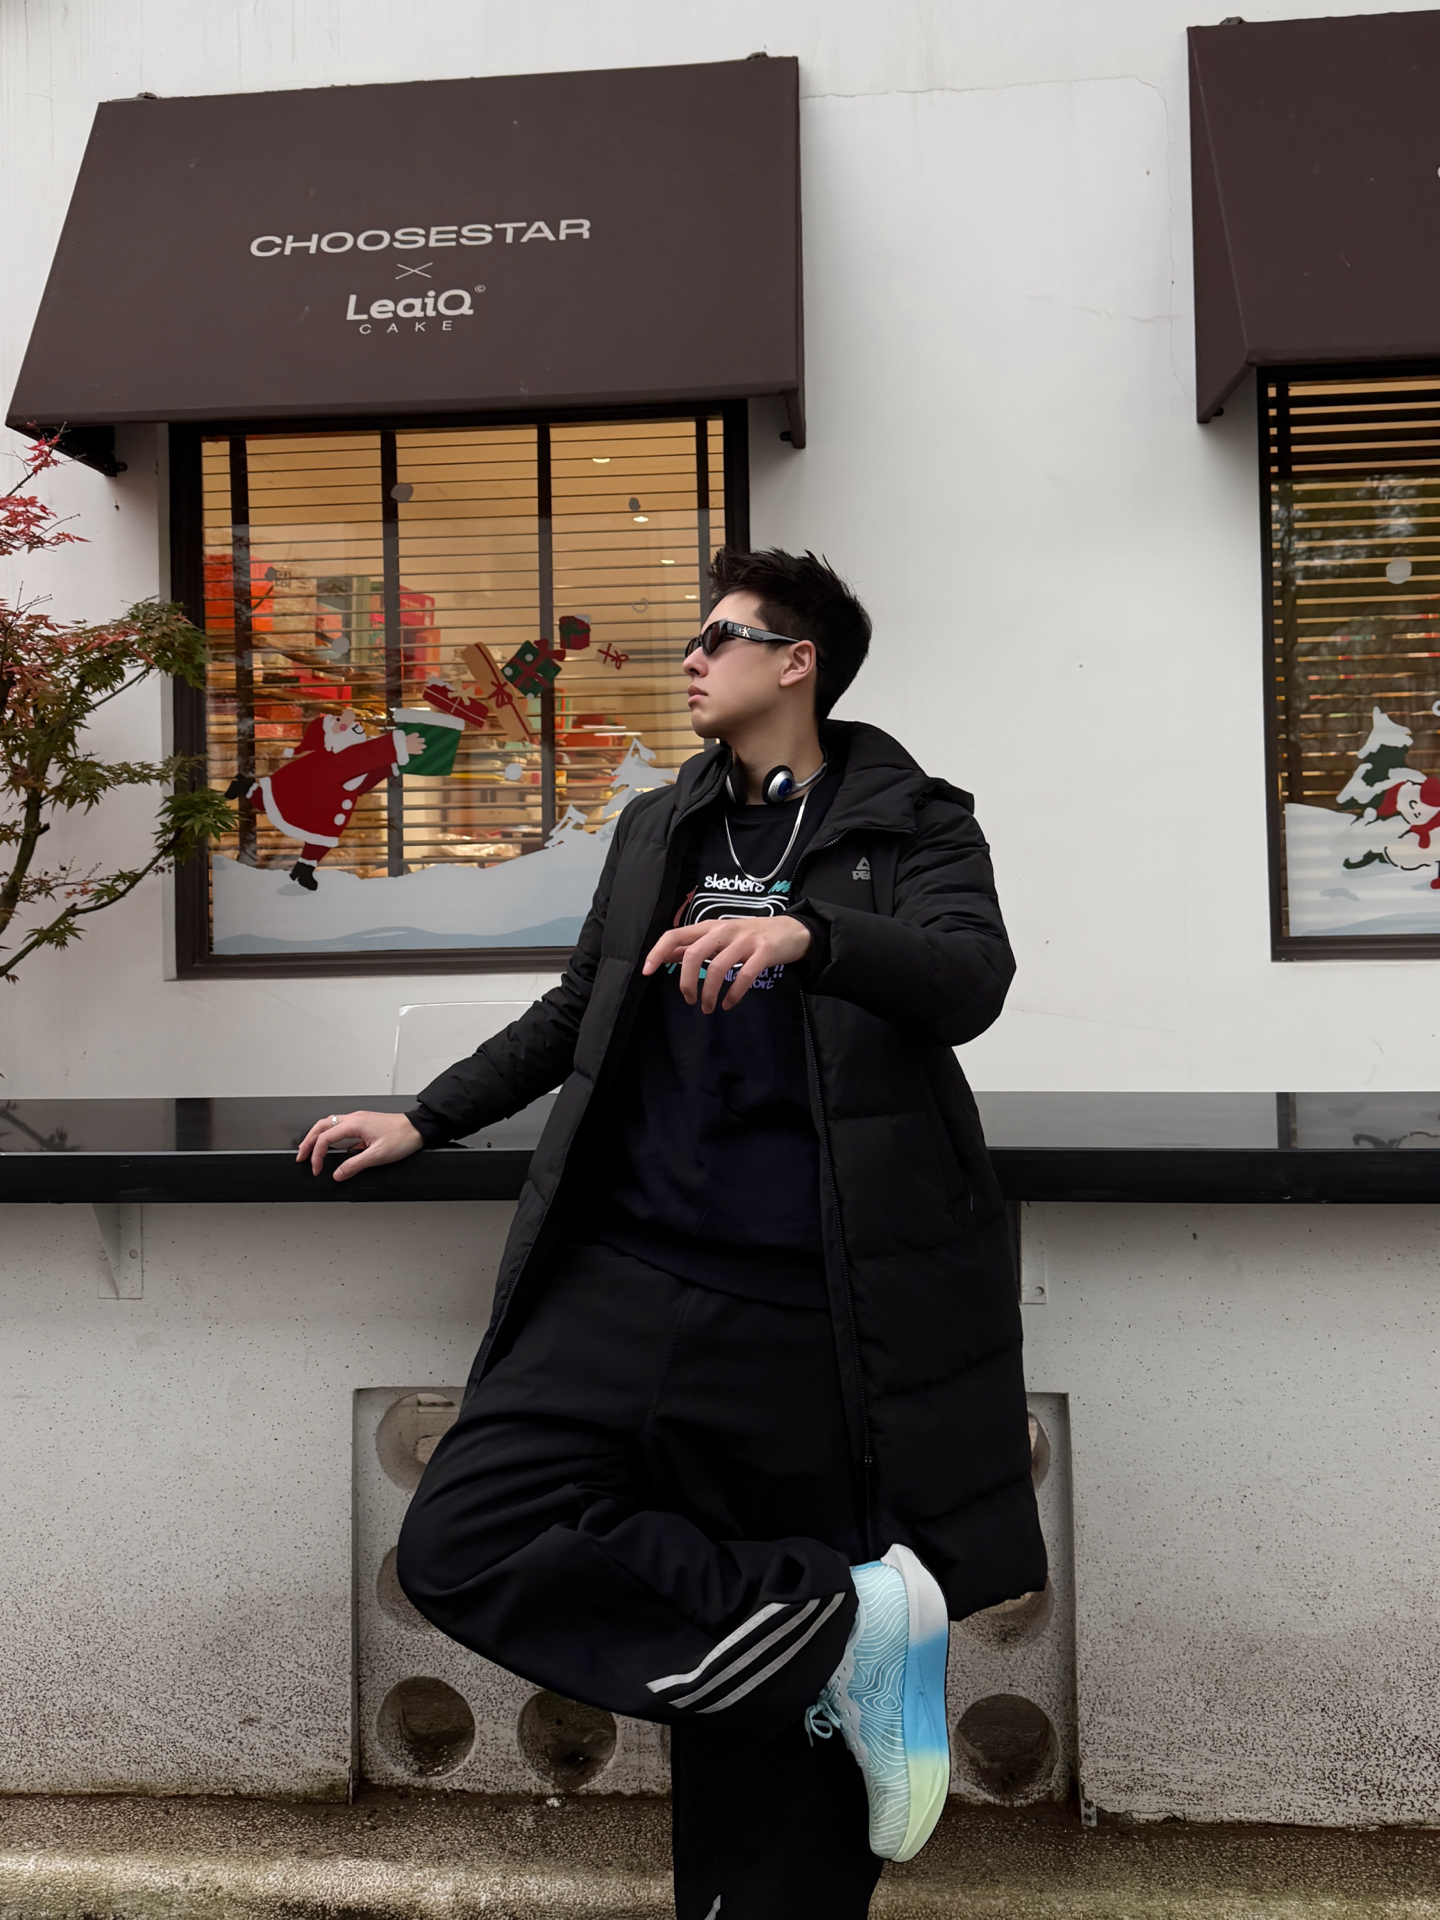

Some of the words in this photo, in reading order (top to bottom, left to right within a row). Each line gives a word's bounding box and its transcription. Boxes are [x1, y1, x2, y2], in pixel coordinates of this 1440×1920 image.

[249, 218, 591, 257] CHOOSESTAR
[359, 320, 453, 335] CAKE
[704, 873, 766, 893] skechers
